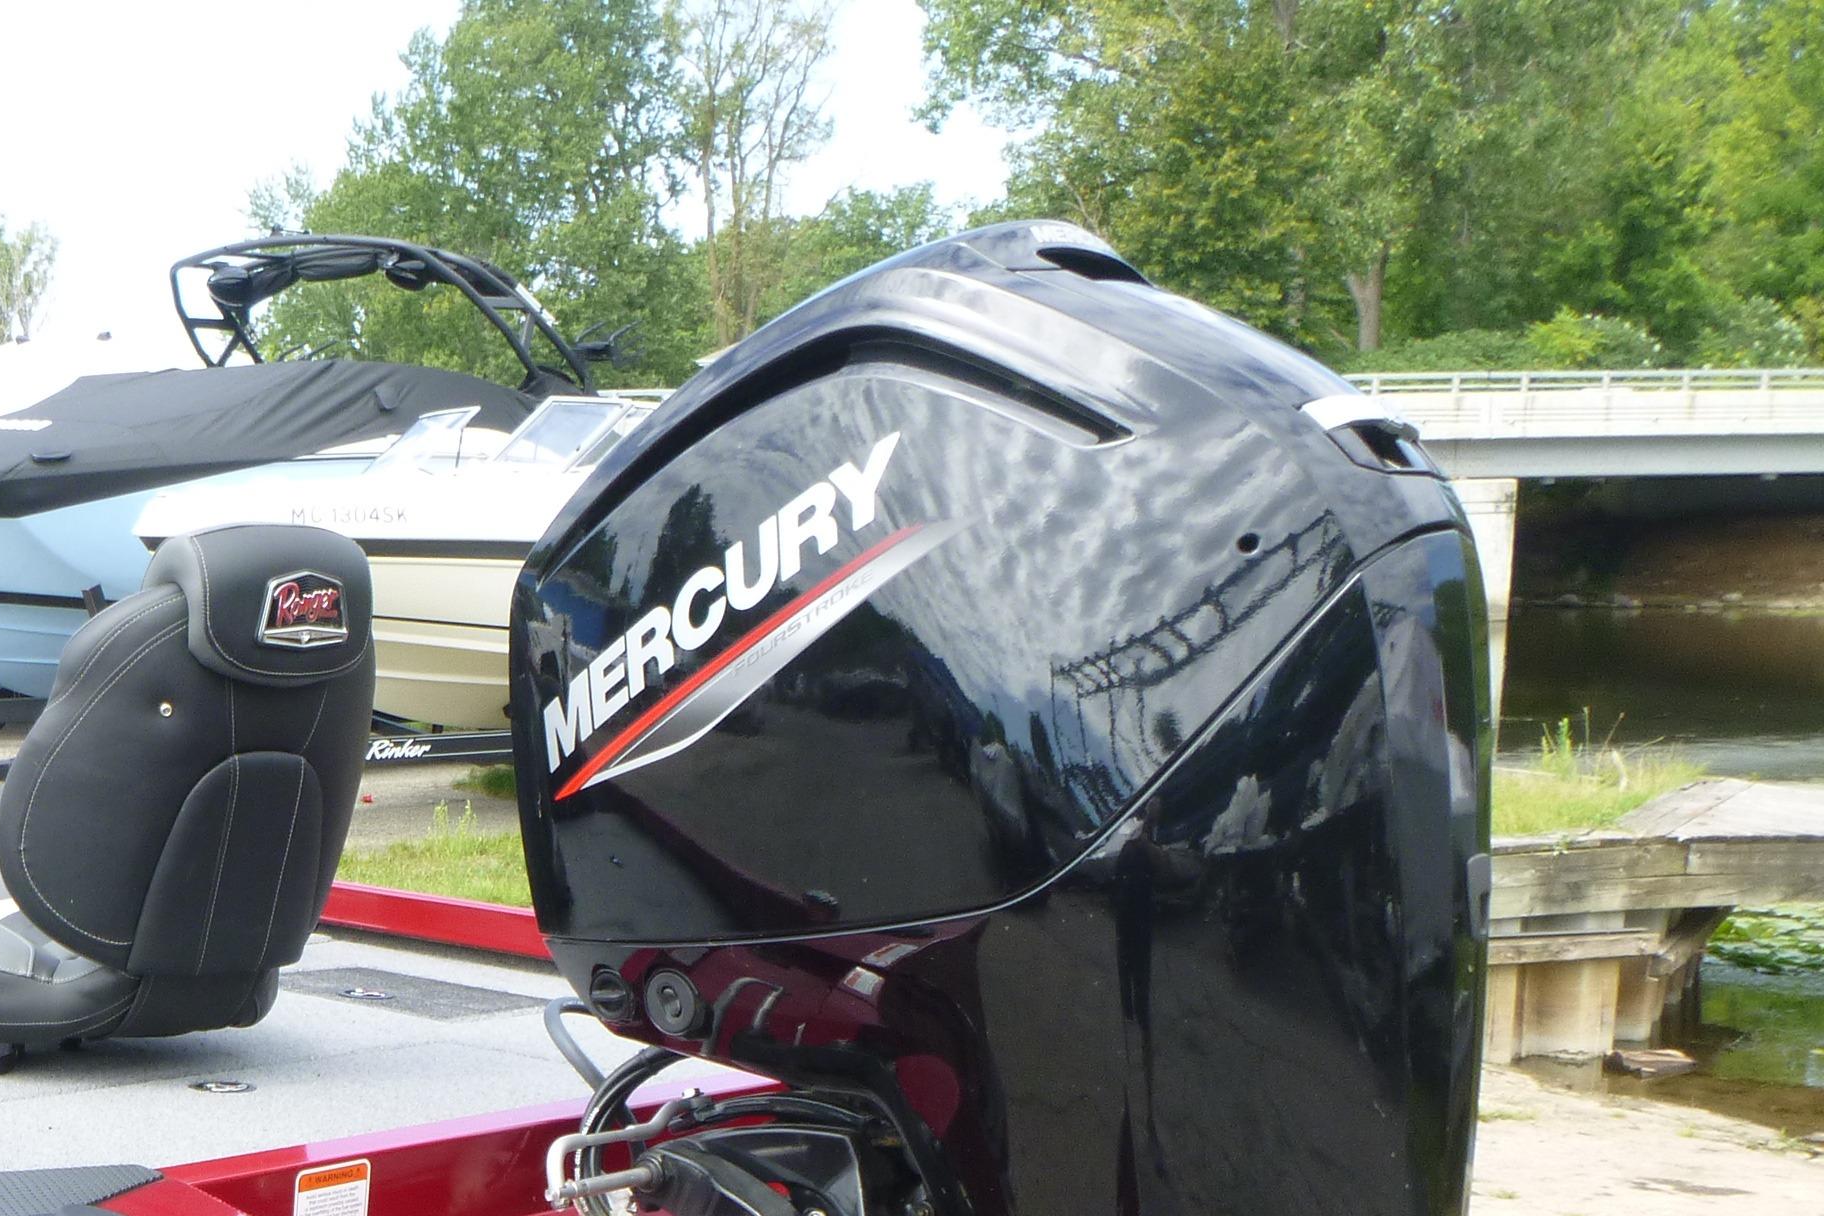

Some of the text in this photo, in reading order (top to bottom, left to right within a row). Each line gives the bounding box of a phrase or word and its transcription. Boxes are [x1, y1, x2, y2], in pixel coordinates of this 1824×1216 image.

[273, 581, 339, 628] Ranger
[543, 431, 901, 774] MERCURY
[732, 568, 874, 677] FOURSTROKE
[365, 738, 432, 761] Rinker
[314, 1168, 354, 1185] WARNING
